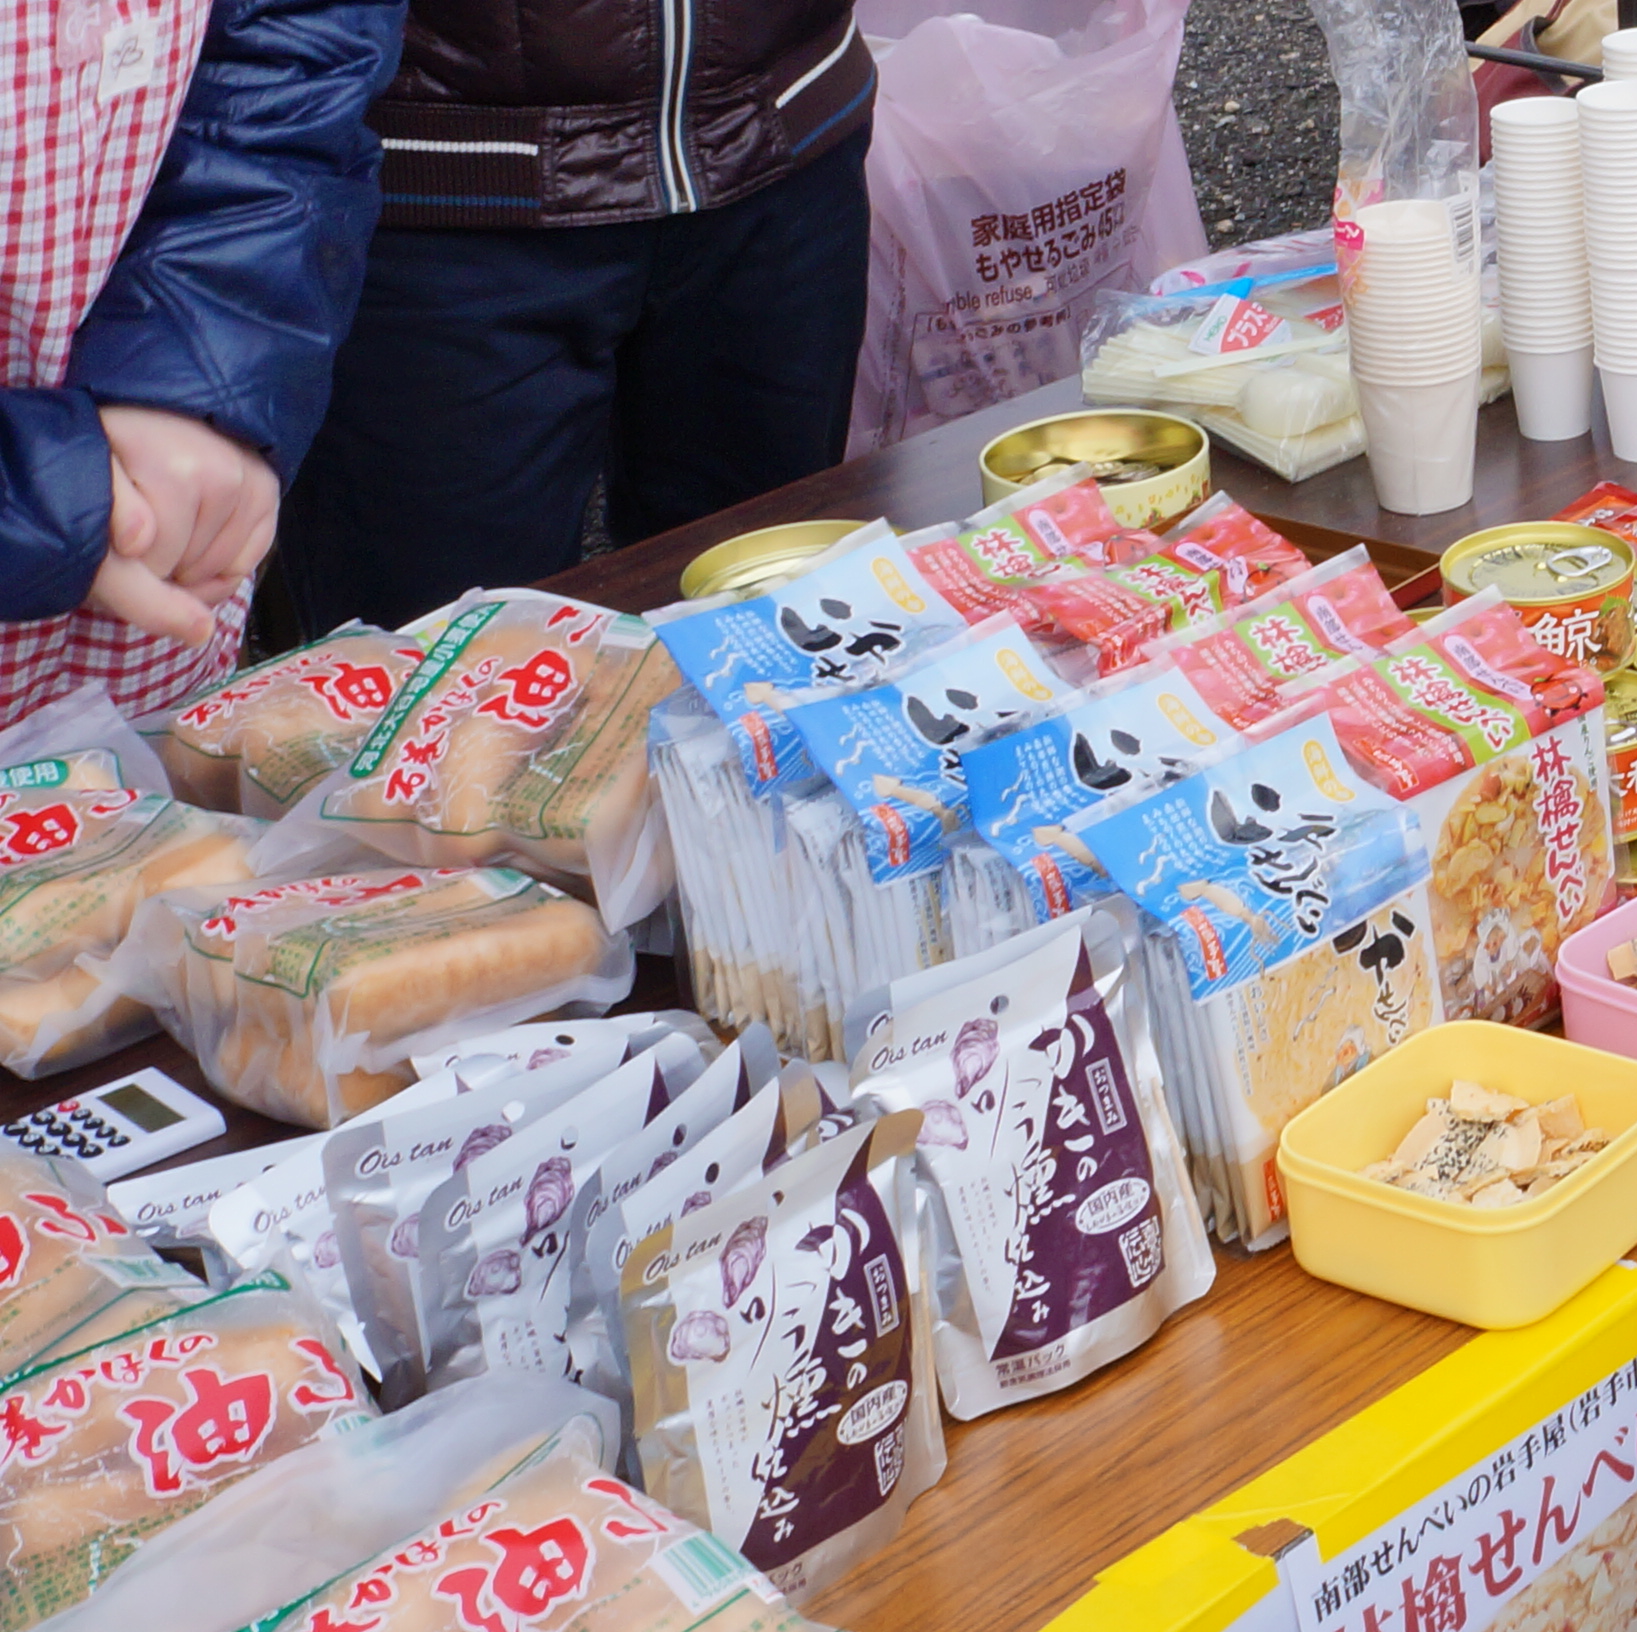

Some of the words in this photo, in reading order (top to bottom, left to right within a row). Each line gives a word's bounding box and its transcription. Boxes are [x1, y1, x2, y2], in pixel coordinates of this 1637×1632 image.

[970, 167, 1127, 249] 家庭用指定袋
[984, 284, 1034, 308] refuse
[1389, 656, 1514, 752] 林檎せんべい
[1530, 736, 1584, 920] 林檎せんべい
[872, 1044, 906, 1071] Ois
[909, 1030, 948, 1057] tan
[1093, 1068, 1120, 1126] おつまみ
[359, 1145, 406, 1176] Ois
[409, 1134, 454, 1162] tan
[137, 1201, 178, 1221] Ois
[184, 1188, 223, 1210] tan
[447, 1195, 485, 1228] Ois
[487, 1174, 523, 1203] tan
[1087, 1186, 1135, 1218] 国内産
[645, 1248, 684, 1279] Ois
[685, 1232, 721, 1264] tan
[871, 1266, 895, 1329] おつまみ
[849, 1386, 898, 1424] 国内産
